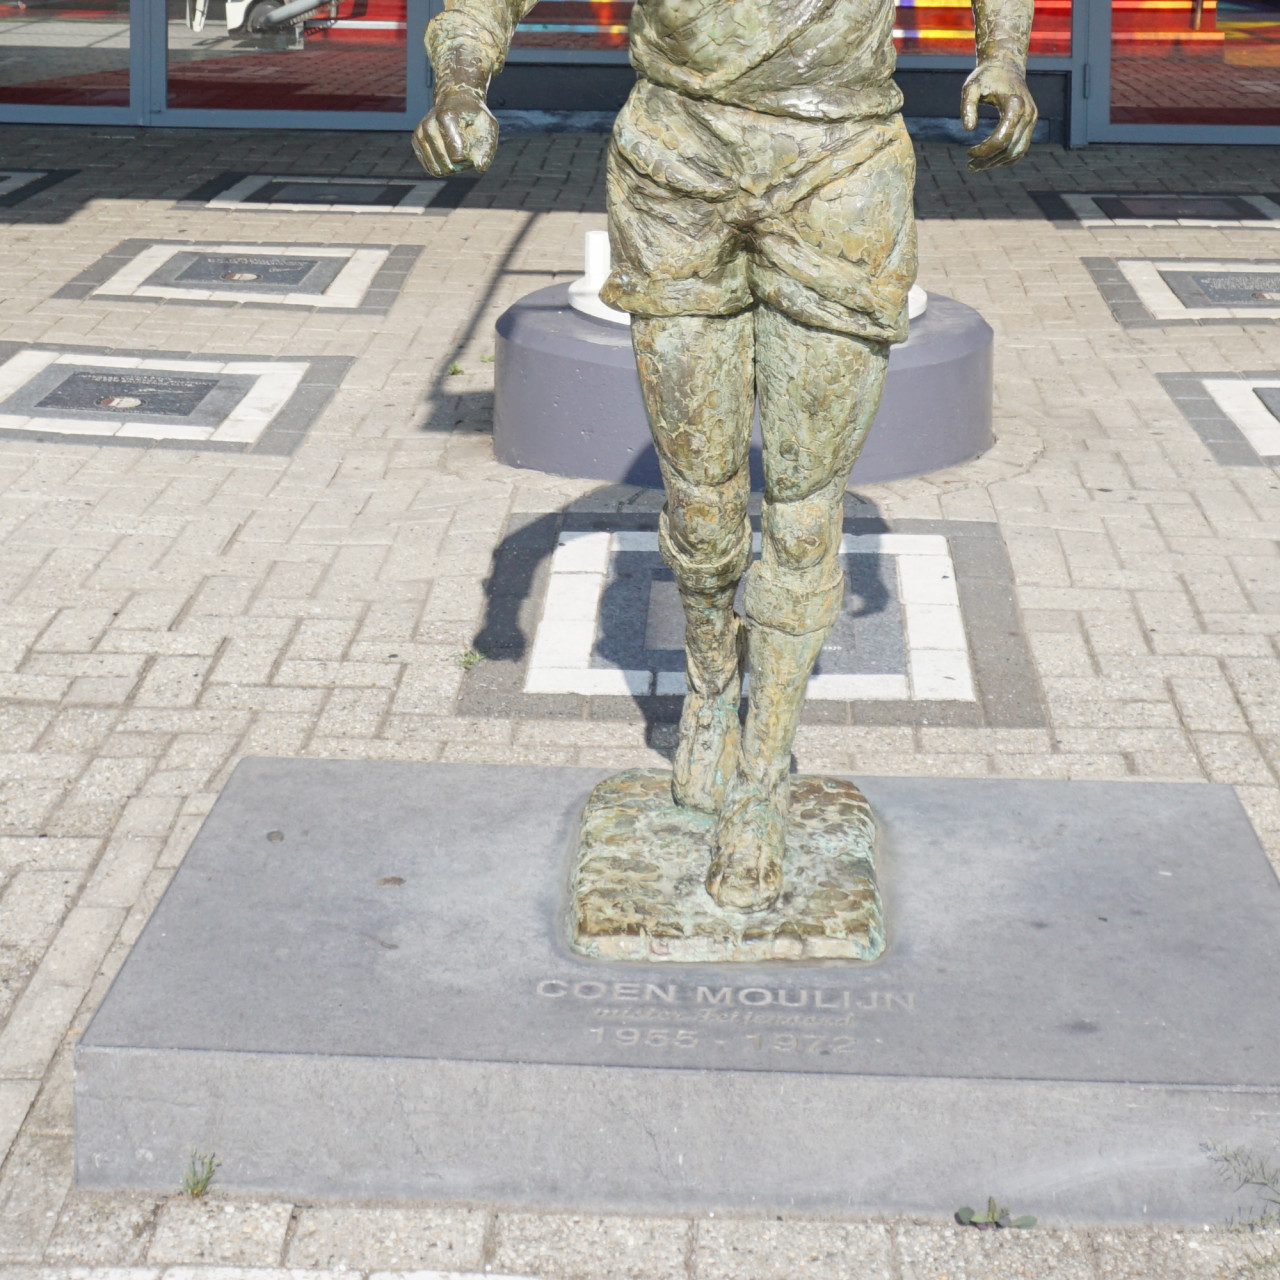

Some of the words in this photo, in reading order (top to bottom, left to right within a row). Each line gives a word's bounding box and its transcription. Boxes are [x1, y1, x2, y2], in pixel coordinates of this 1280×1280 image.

[535, 979, 677, 1005] COEN
[695, 986, 919, 1012] MOULIJN
[588, 1027, 700, 1049] 1955
[744, 1032, 858, 1054] 1972
